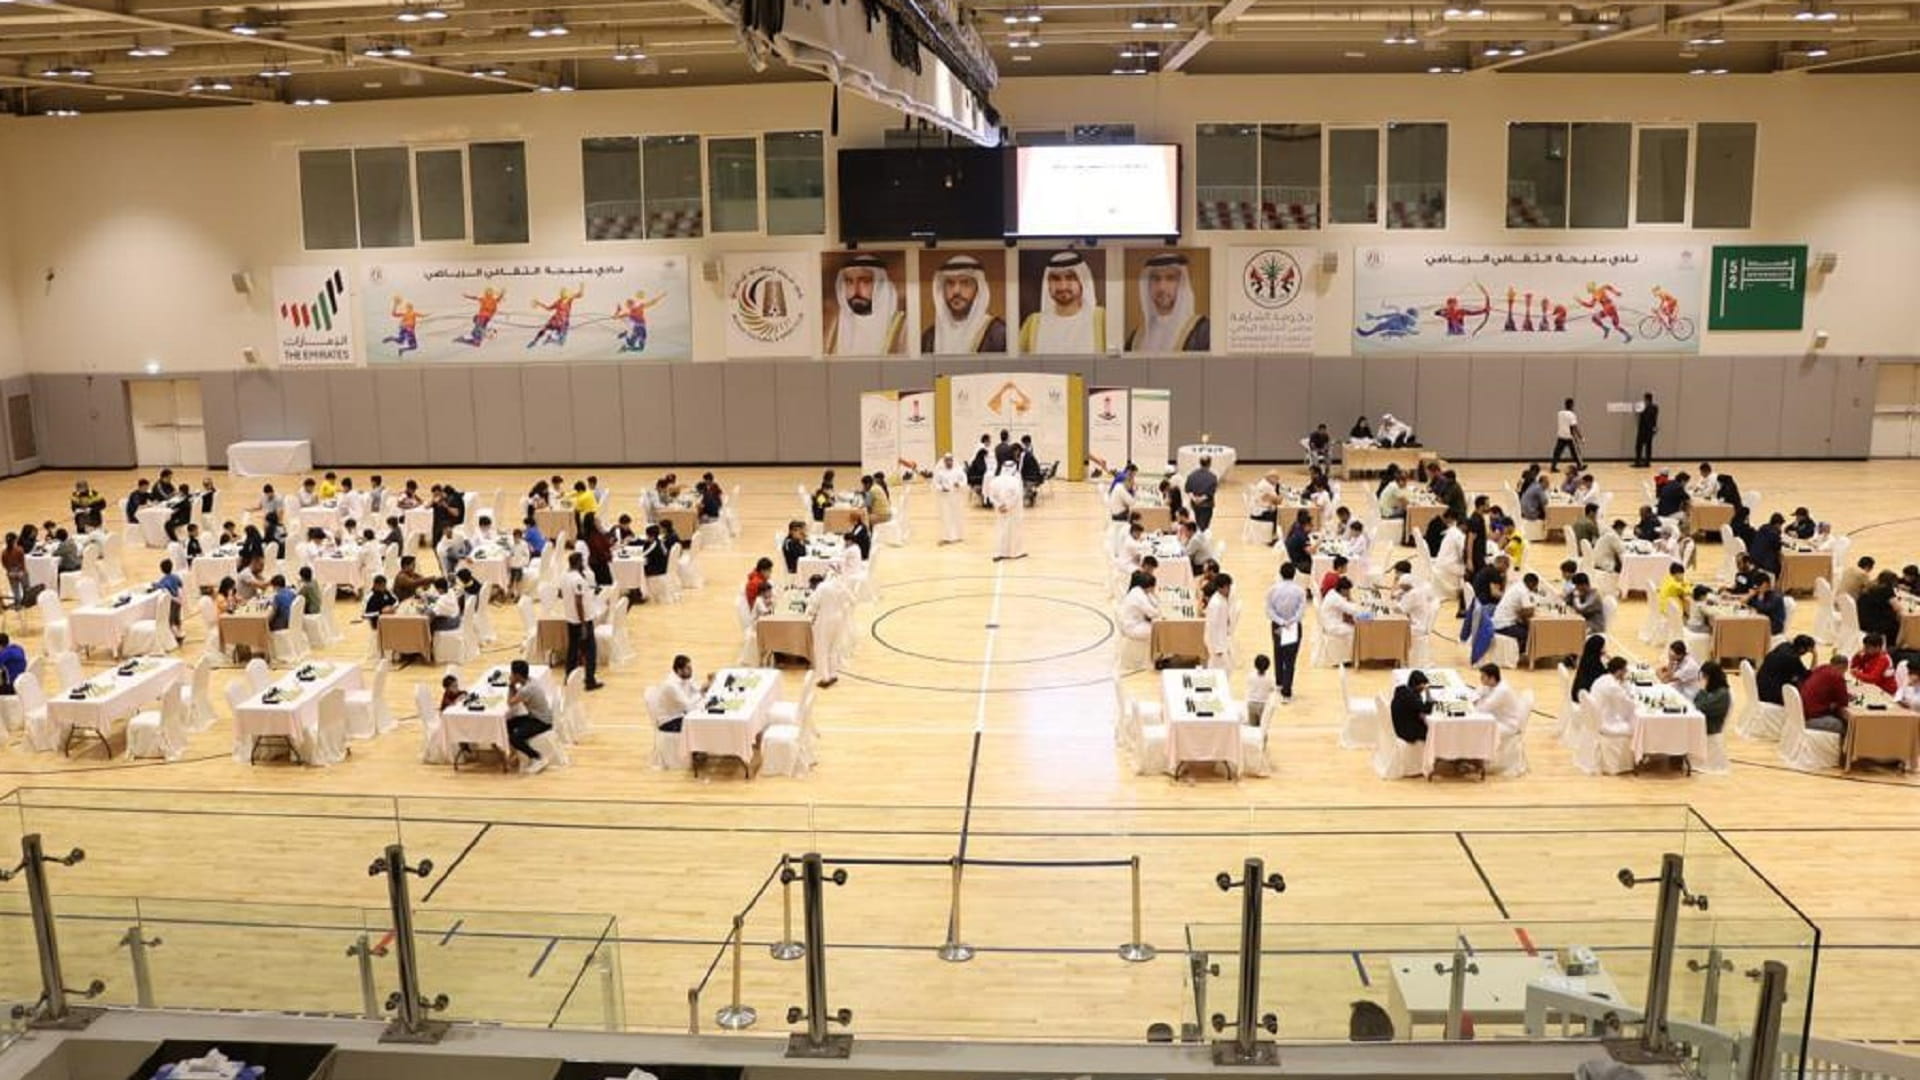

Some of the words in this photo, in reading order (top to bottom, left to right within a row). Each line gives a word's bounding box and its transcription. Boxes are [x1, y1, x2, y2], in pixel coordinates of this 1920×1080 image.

[1424, 252, 1490, 266] الرياضي
[1491, 252, 1552, 266] الثقافي
[1555, 252, 1608, 264] مليحة
[1608, 252, 1639, 266] نادي
[284, 350, 302, 360] THE
[302, 349, 350, 360] EMIRATES
